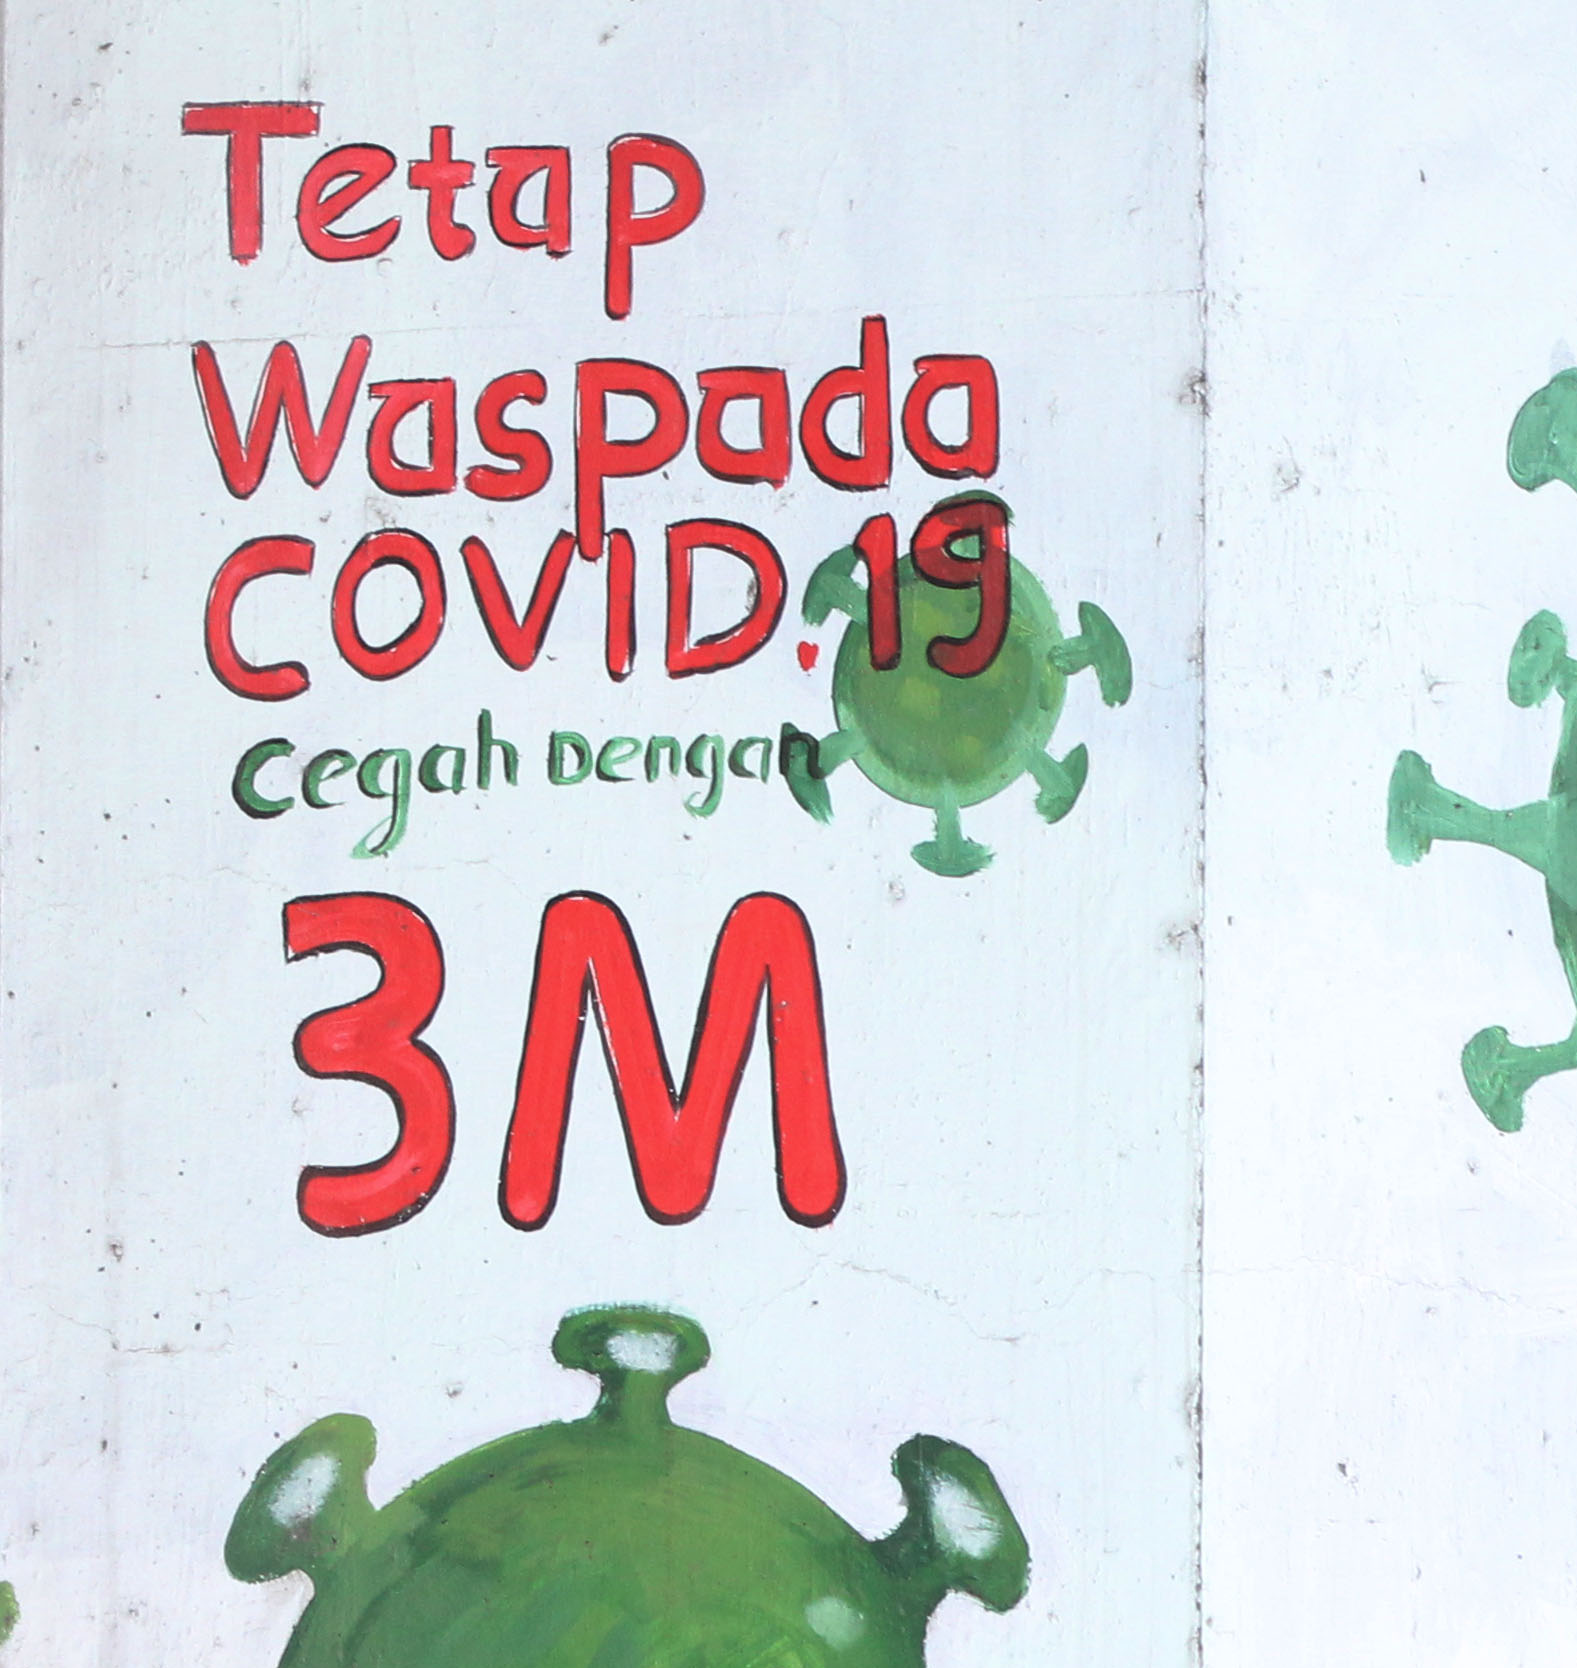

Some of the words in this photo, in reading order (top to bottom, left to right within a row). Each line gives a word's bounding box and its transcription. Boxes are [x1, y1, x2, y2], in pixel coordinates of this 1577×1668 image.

[182, 101, 706, 319] Tetap
[191, 314, 1000, 560] Waspada
[284, 890, 848, 1238] 3M
